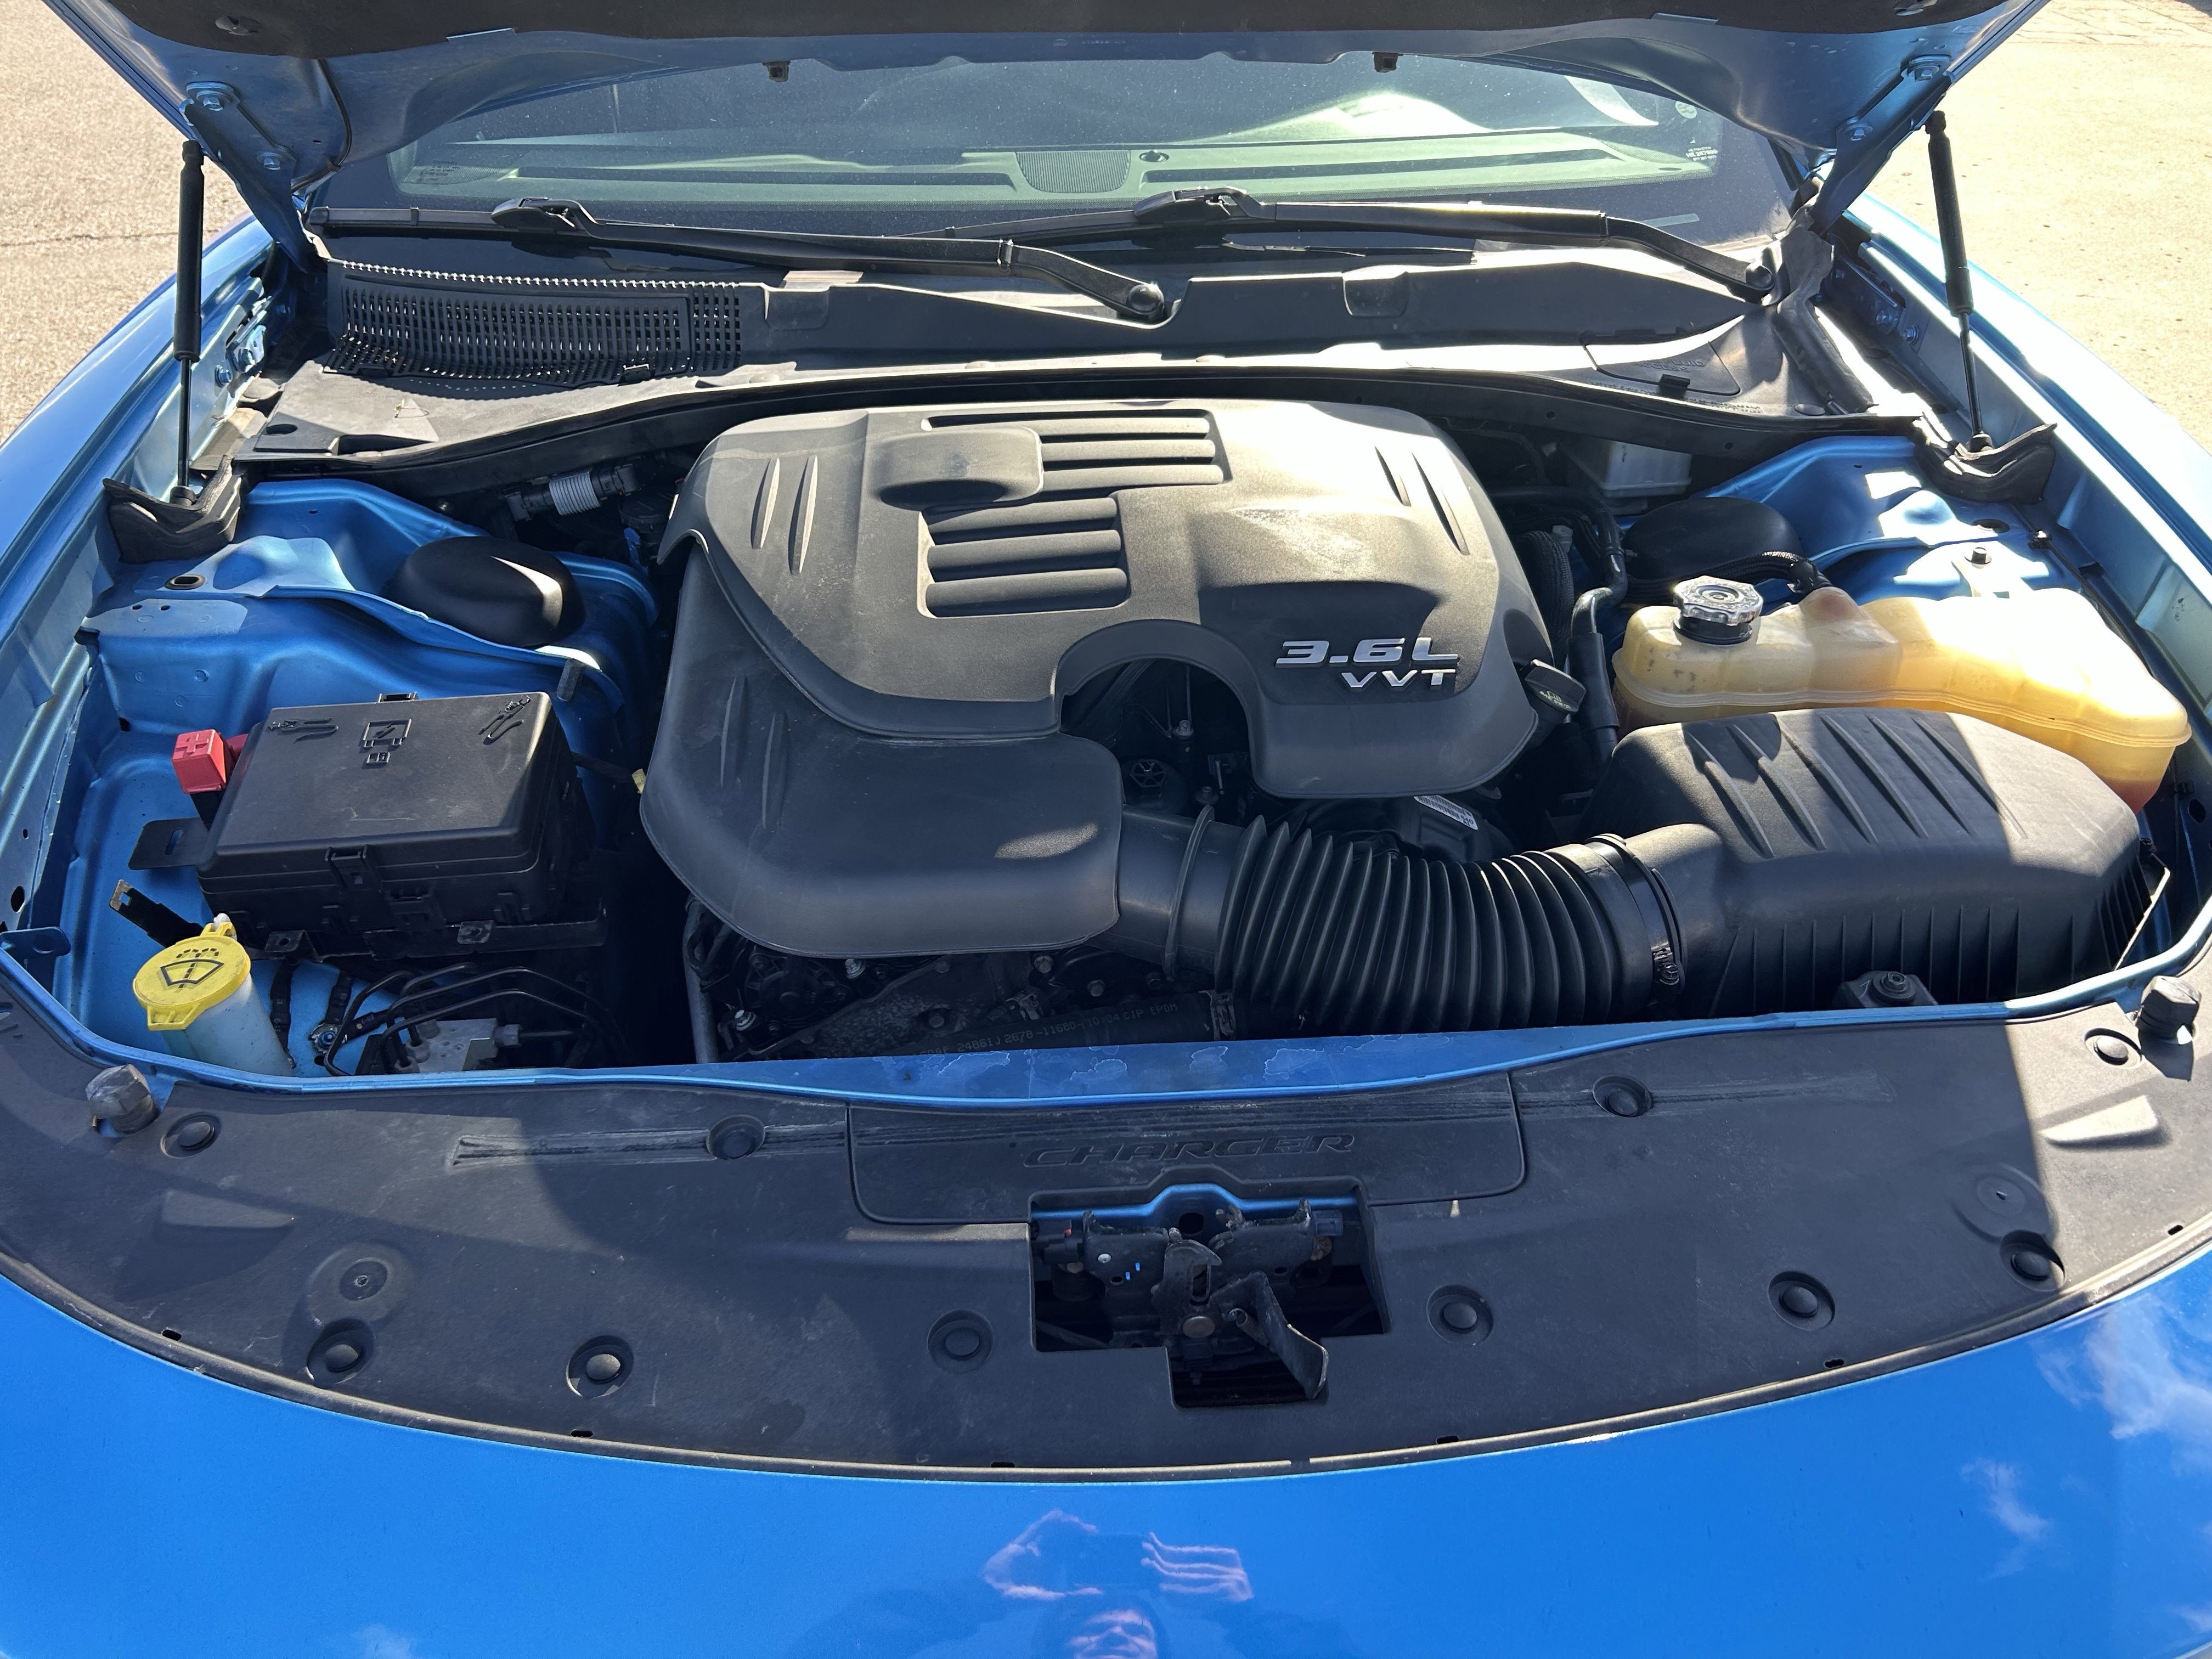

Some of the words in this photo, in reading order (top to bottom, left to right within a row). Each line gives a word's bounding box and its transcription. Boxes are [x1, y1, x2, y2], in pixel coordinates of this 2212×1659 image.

[1275, 637, 1460, 668] 3.6L
[1341, 669, 1456, 691] VVT
[1150, 1002, 1178, 1015] EPDM
[1023, 1133, 1355, 1167] CHARGER
